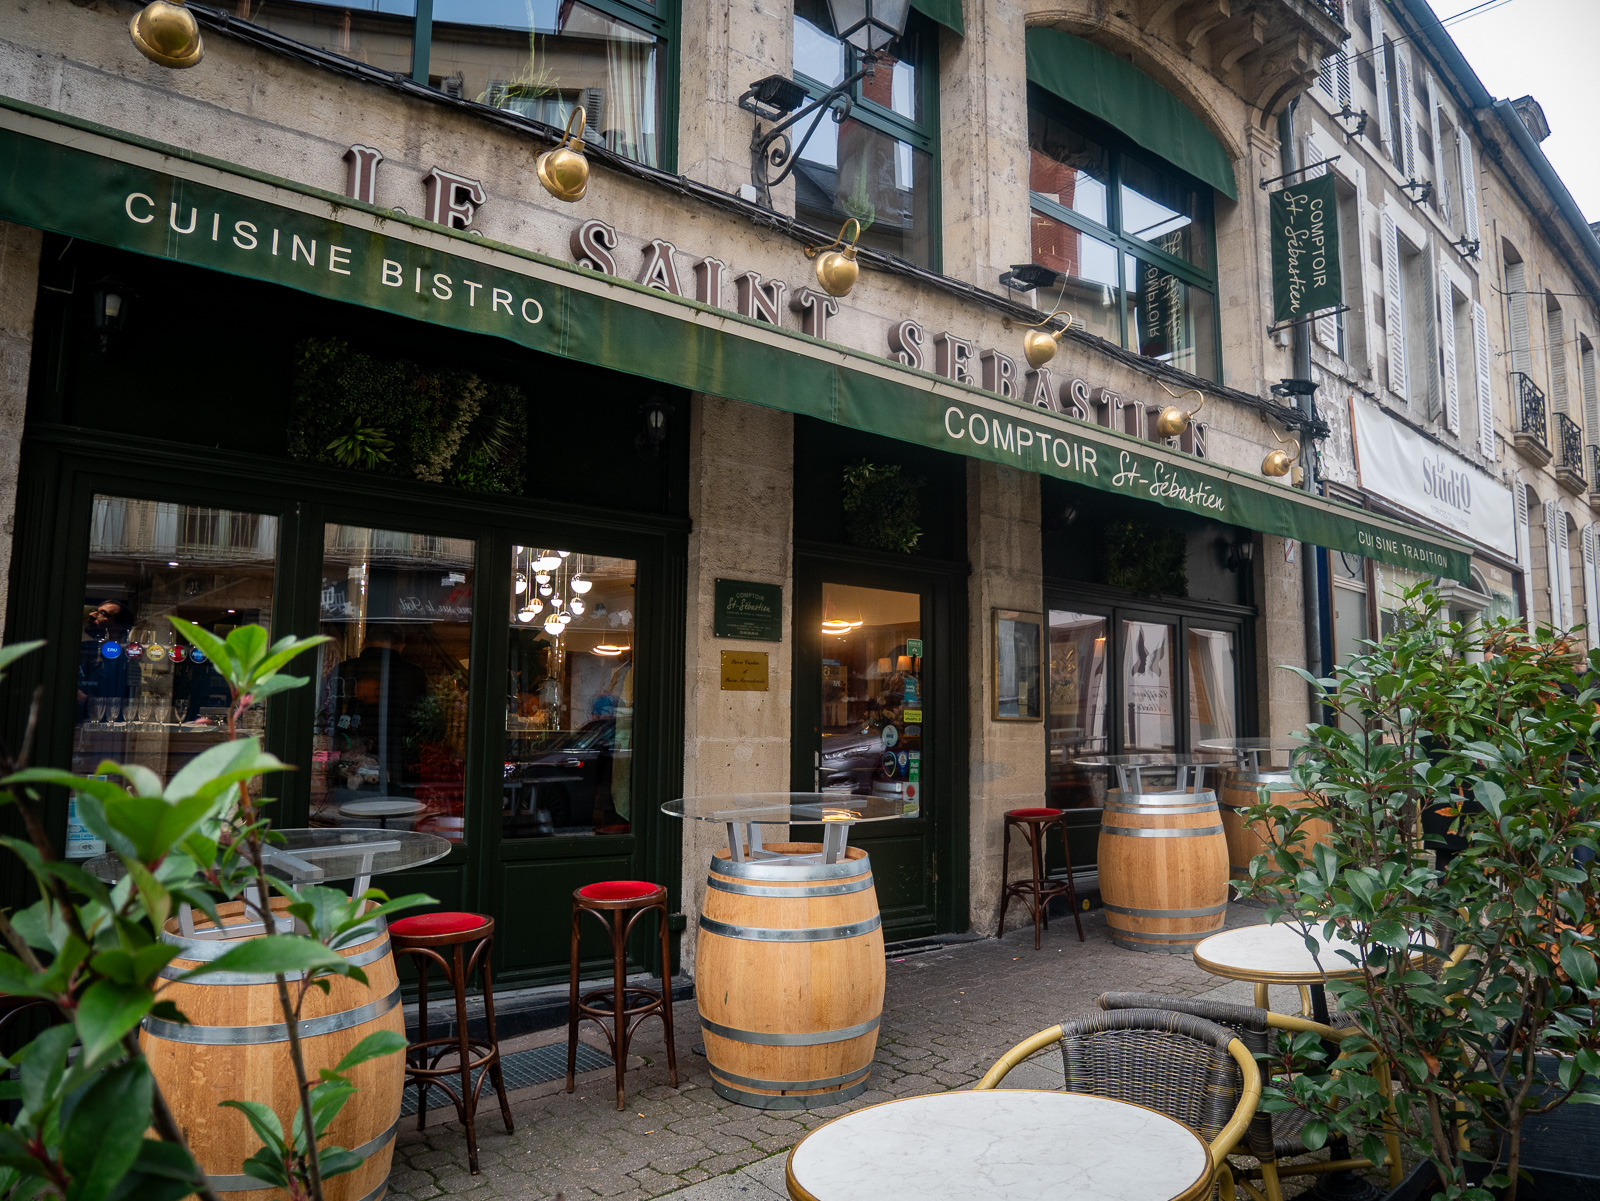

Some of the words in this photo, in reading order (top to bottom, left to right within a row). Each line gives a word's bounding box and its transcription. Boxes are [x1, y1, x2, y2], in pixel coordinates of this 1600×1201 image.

[125, 192, 352, 275] CUISINE
[381, 259, 544, 324] BISTRO
[570, 219, 839, 341] SAINT
[1283, 191, 1309, 313] St-Sébastien
[1310, 199, 1327, 288] COMPTOIR
[944, 406, 1099, 477] COMPTOIR
[1112, 450, 1226, 512] St-Sébastien
[1358, 531, 1398, 555] CUISINE
[1401, 543, 1448, 568] TRADITION
